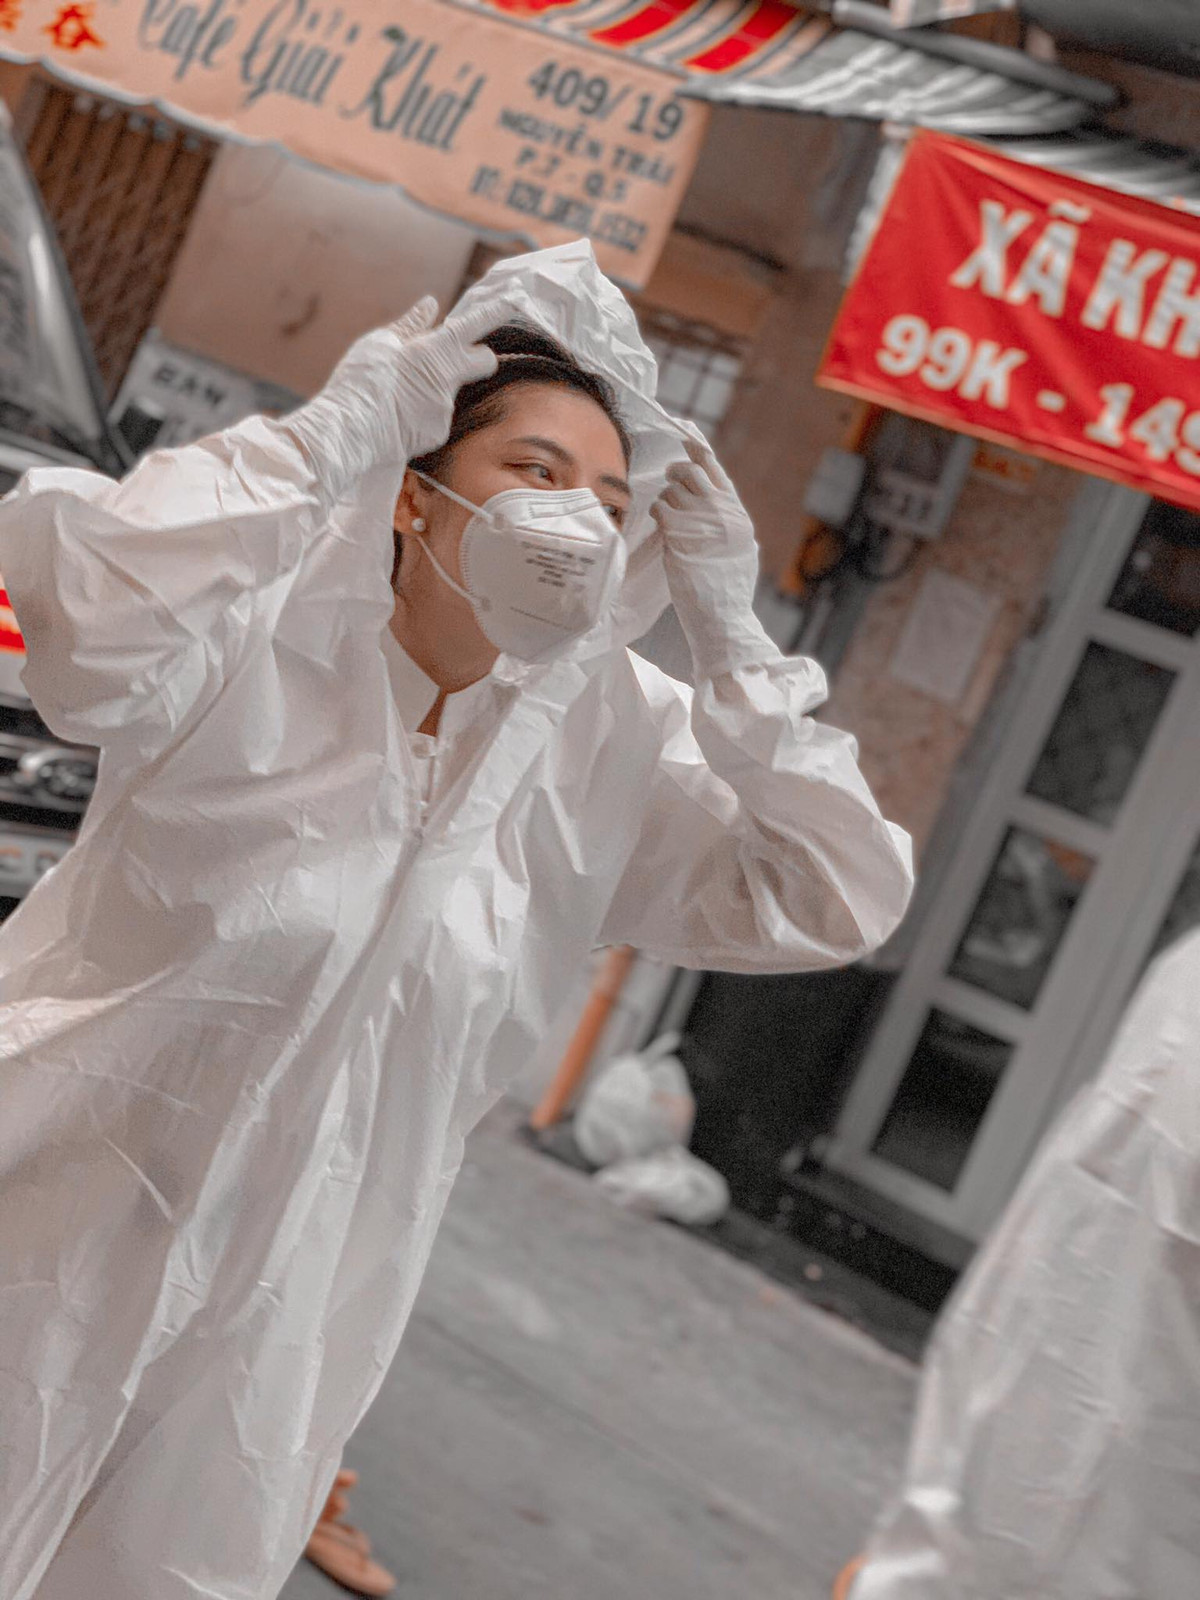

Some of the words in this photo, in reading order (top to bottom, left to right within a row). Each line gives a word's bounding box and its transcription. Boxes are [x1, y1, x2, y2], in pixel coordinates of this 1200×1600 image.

[336, 24, 487, 154] Khát
[528, 61, 686, 142] 409/19
[949, 198, 1092, 318] XÃ
[875, 314, 1028, 410] 99K
